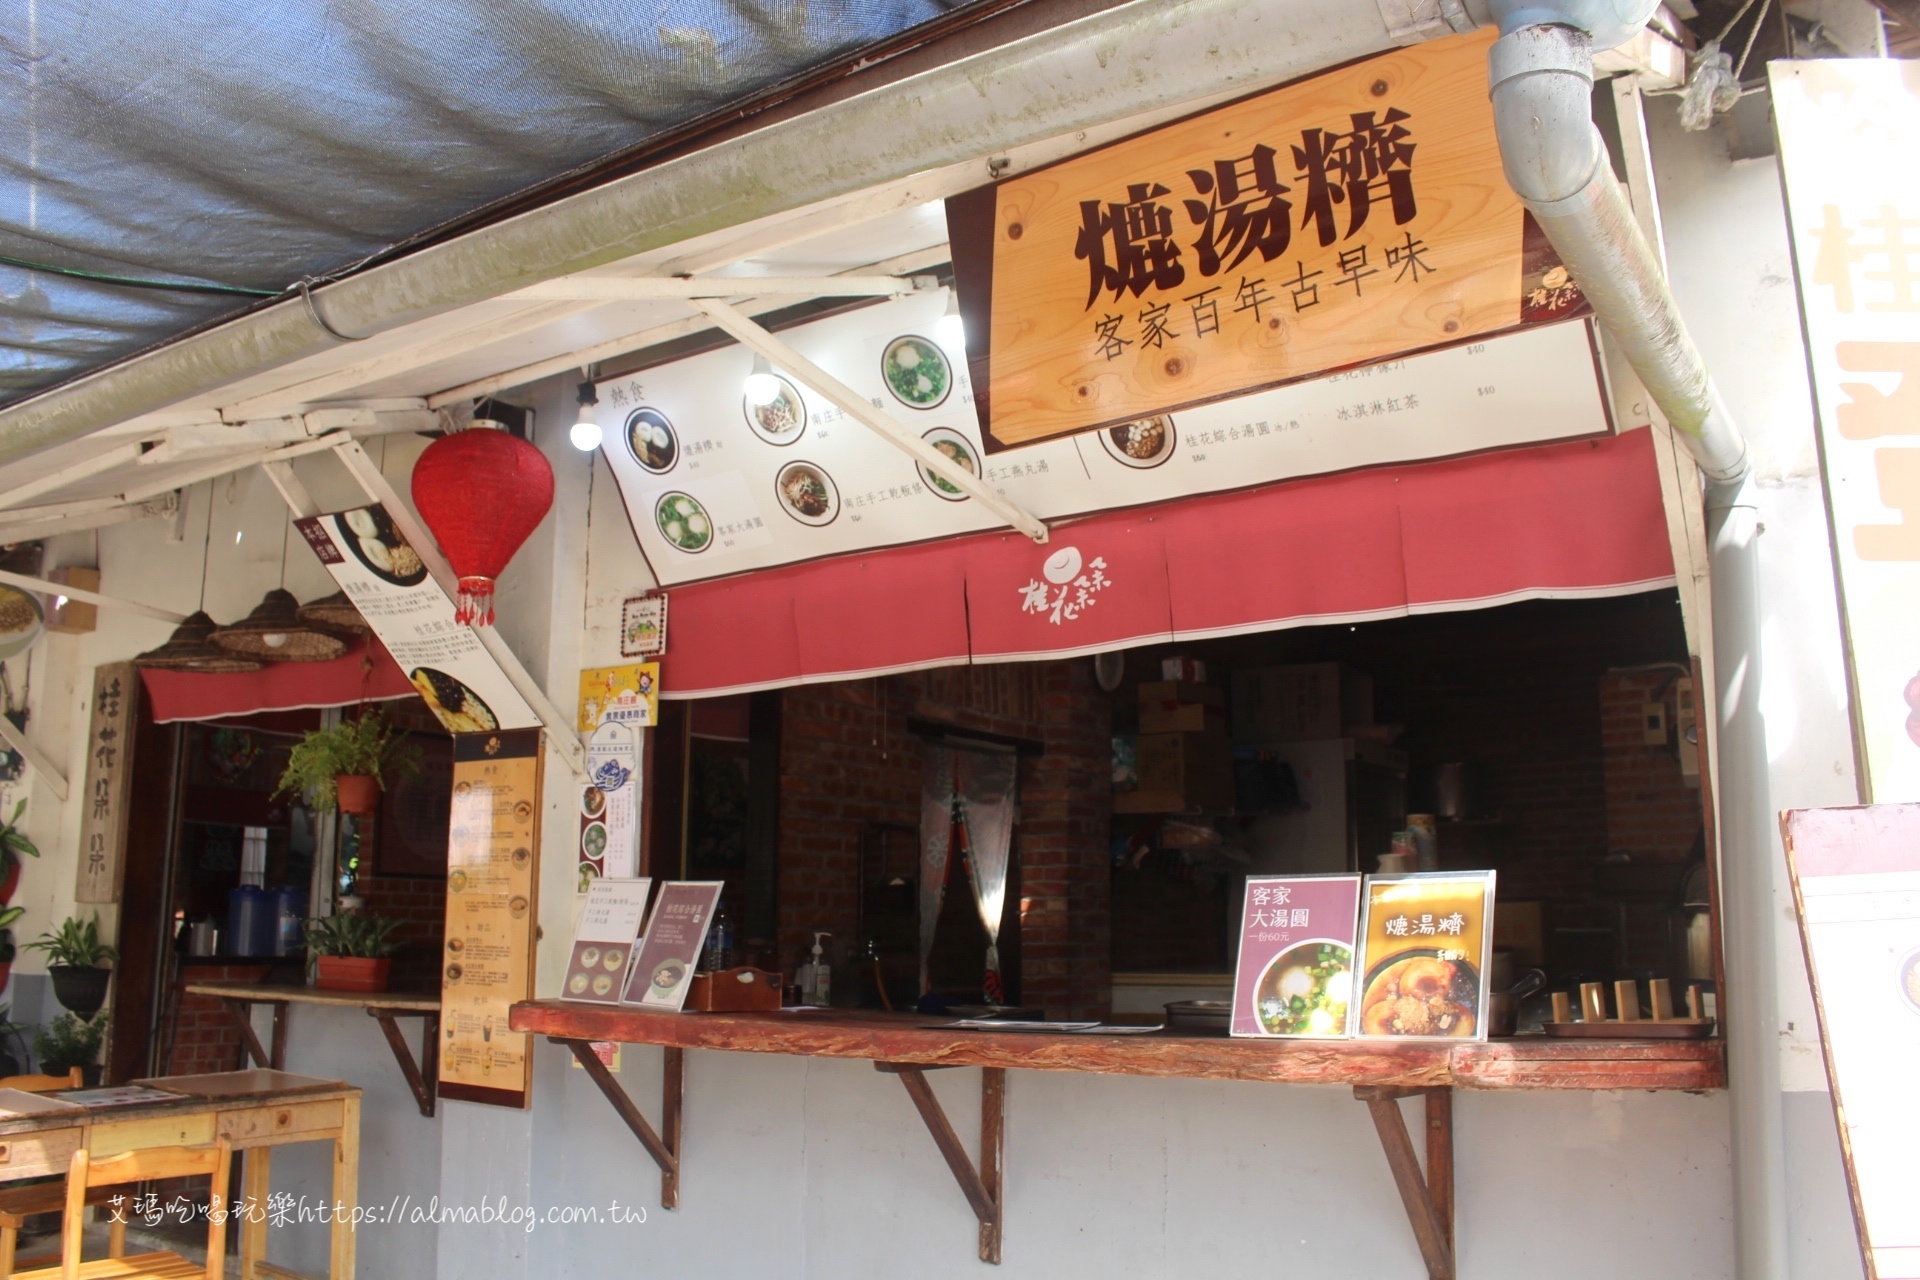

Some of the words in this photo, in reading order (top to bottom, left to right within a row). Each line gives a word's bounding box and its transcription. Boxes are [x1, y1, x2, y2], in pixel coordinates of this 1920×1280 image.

[1094, 231, 1437, 360] 客家百年古早味
[611, 380, 645, 408] 熱食
[1337, 393, 1420, 421] 冰淇淋紅茶
[811, 397, 883, 425] 南庄手麵
[1185, 421, 1270, 447] 桂花綜合湯圓
[717, 516, 764, 535] 客家大湯圓
[1252, 886, 1291, 906] 客家
[1249, 908, 1309, 928] 大湯圓
[1249, 931, 1290, 942] 一份60元
